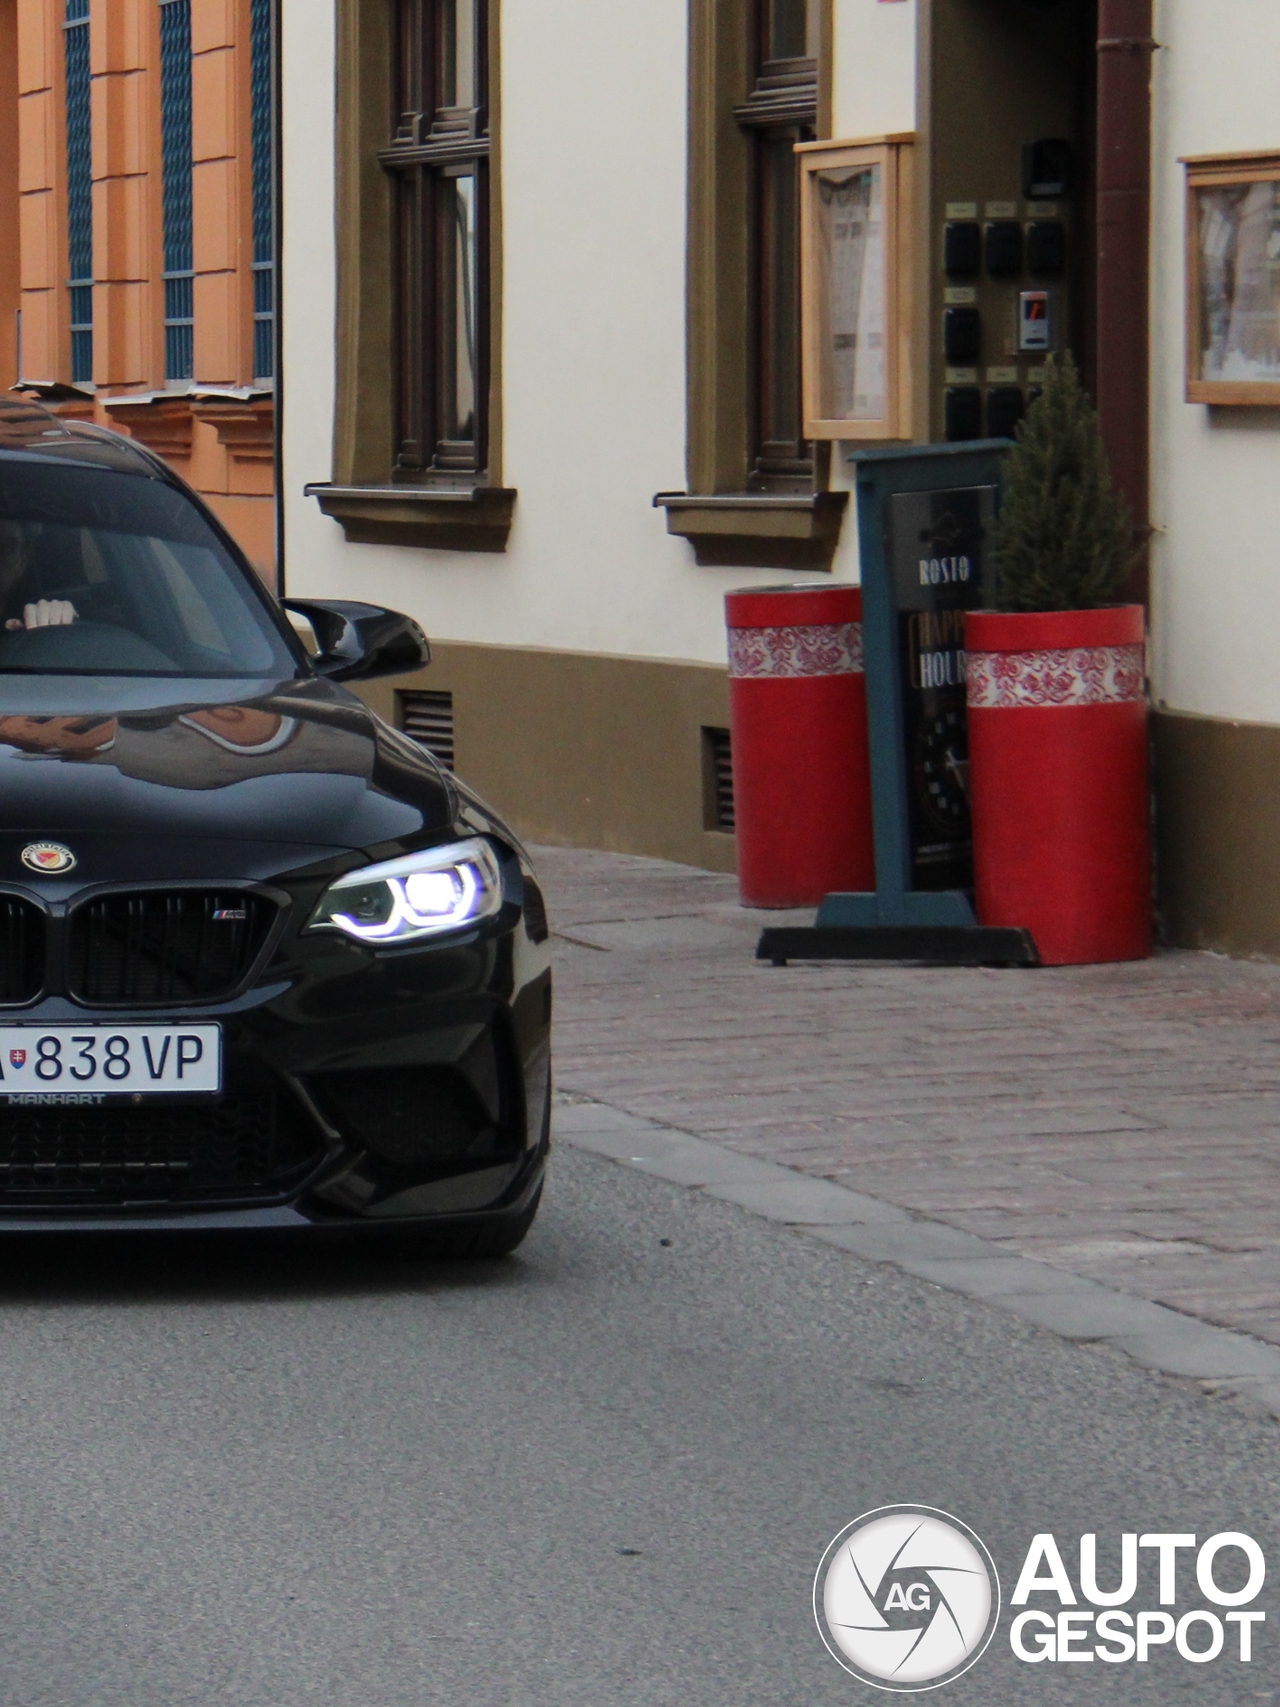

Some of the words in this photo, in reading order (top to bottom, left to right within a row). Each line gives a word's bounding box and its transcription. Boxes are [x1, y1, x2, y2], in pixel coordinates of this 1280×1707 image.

[919, 555, 970, 586] ROSTO
[34, 1034, 204, 1081] 838VP
[8, 1093, 107, 1105] MANHART
